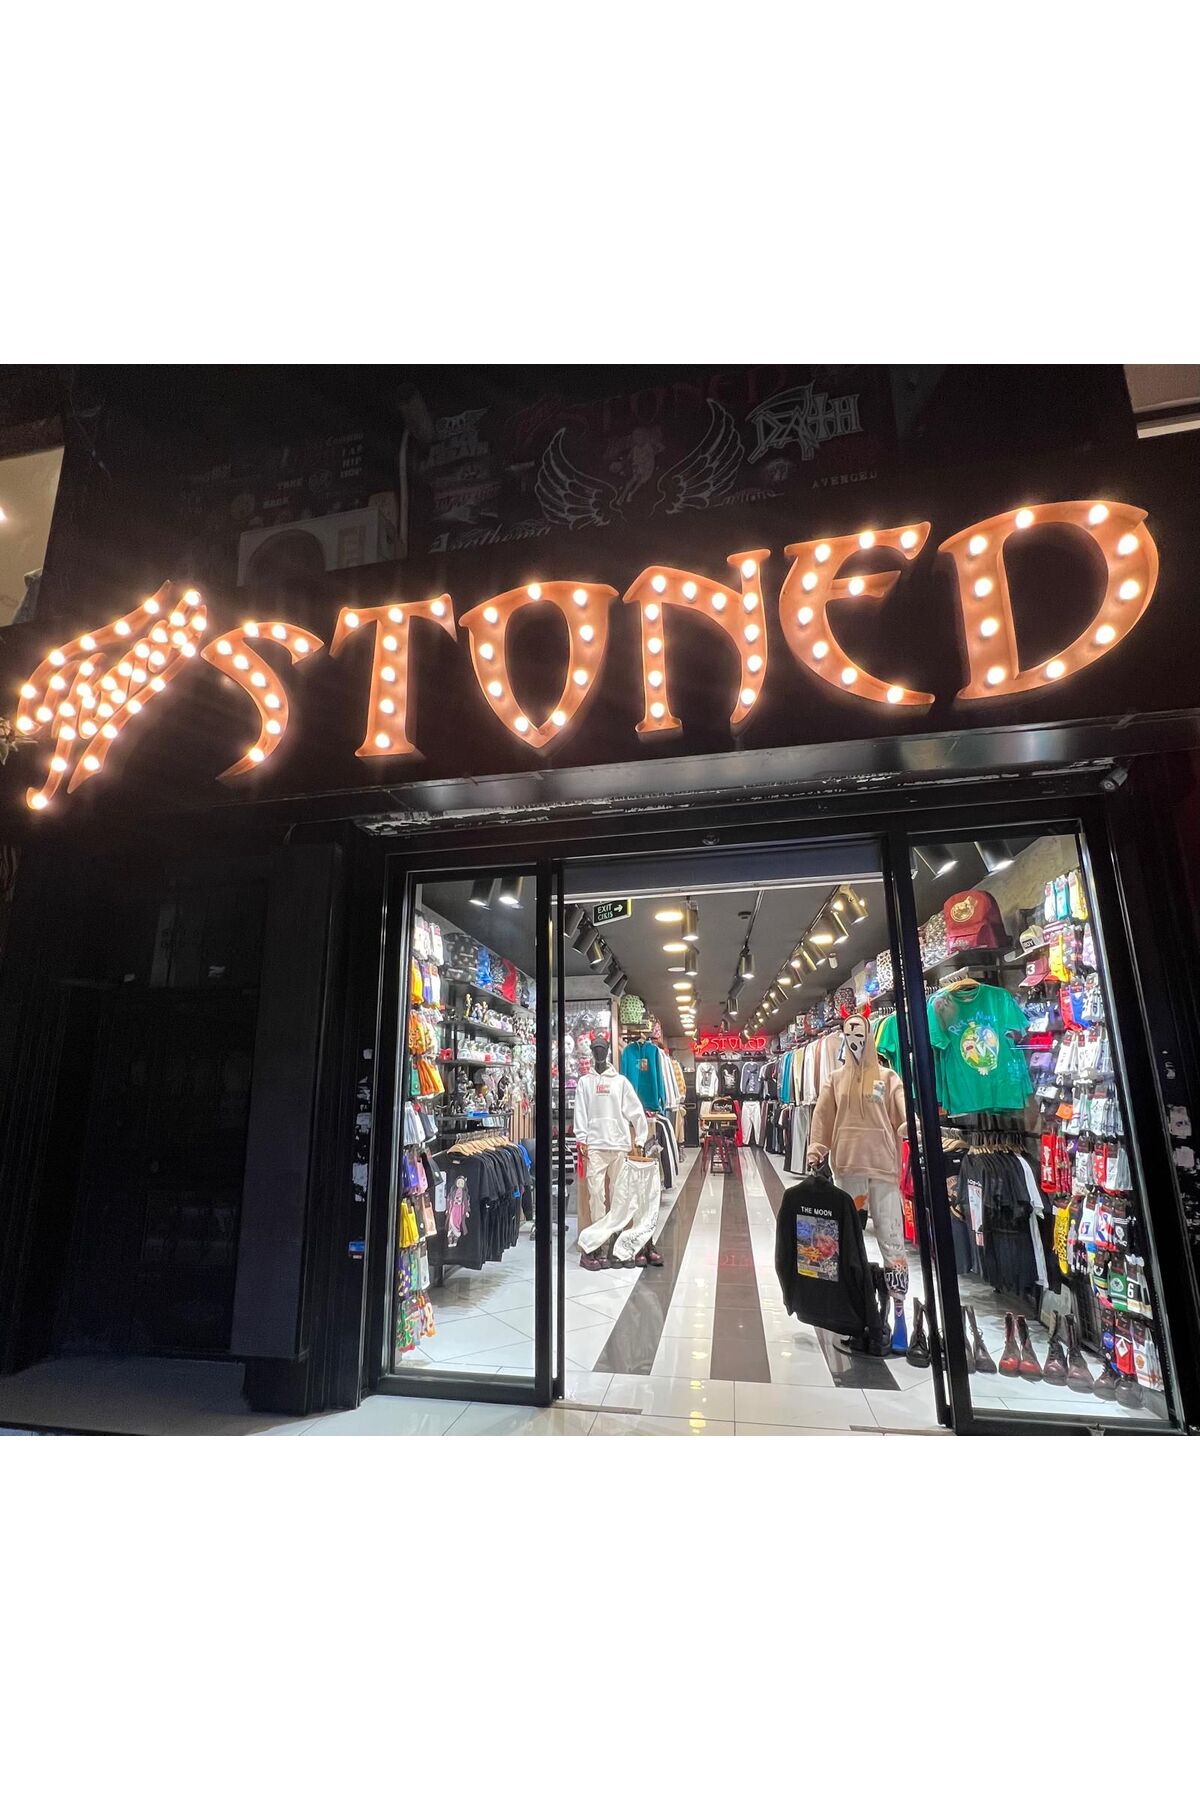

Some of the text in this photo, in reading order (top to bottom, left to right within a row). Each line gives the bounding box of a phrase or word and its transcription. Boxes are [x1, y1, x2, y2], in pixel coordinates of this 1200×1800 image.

[201, 500, 1159, 781] STONED
[597, 903, 613, 914] EXIT
[1027, 963, 1036, 975] 3
[801, 1206, 833, 1217] THE MOON
[1127, 1283, 1134, 1298] 6
